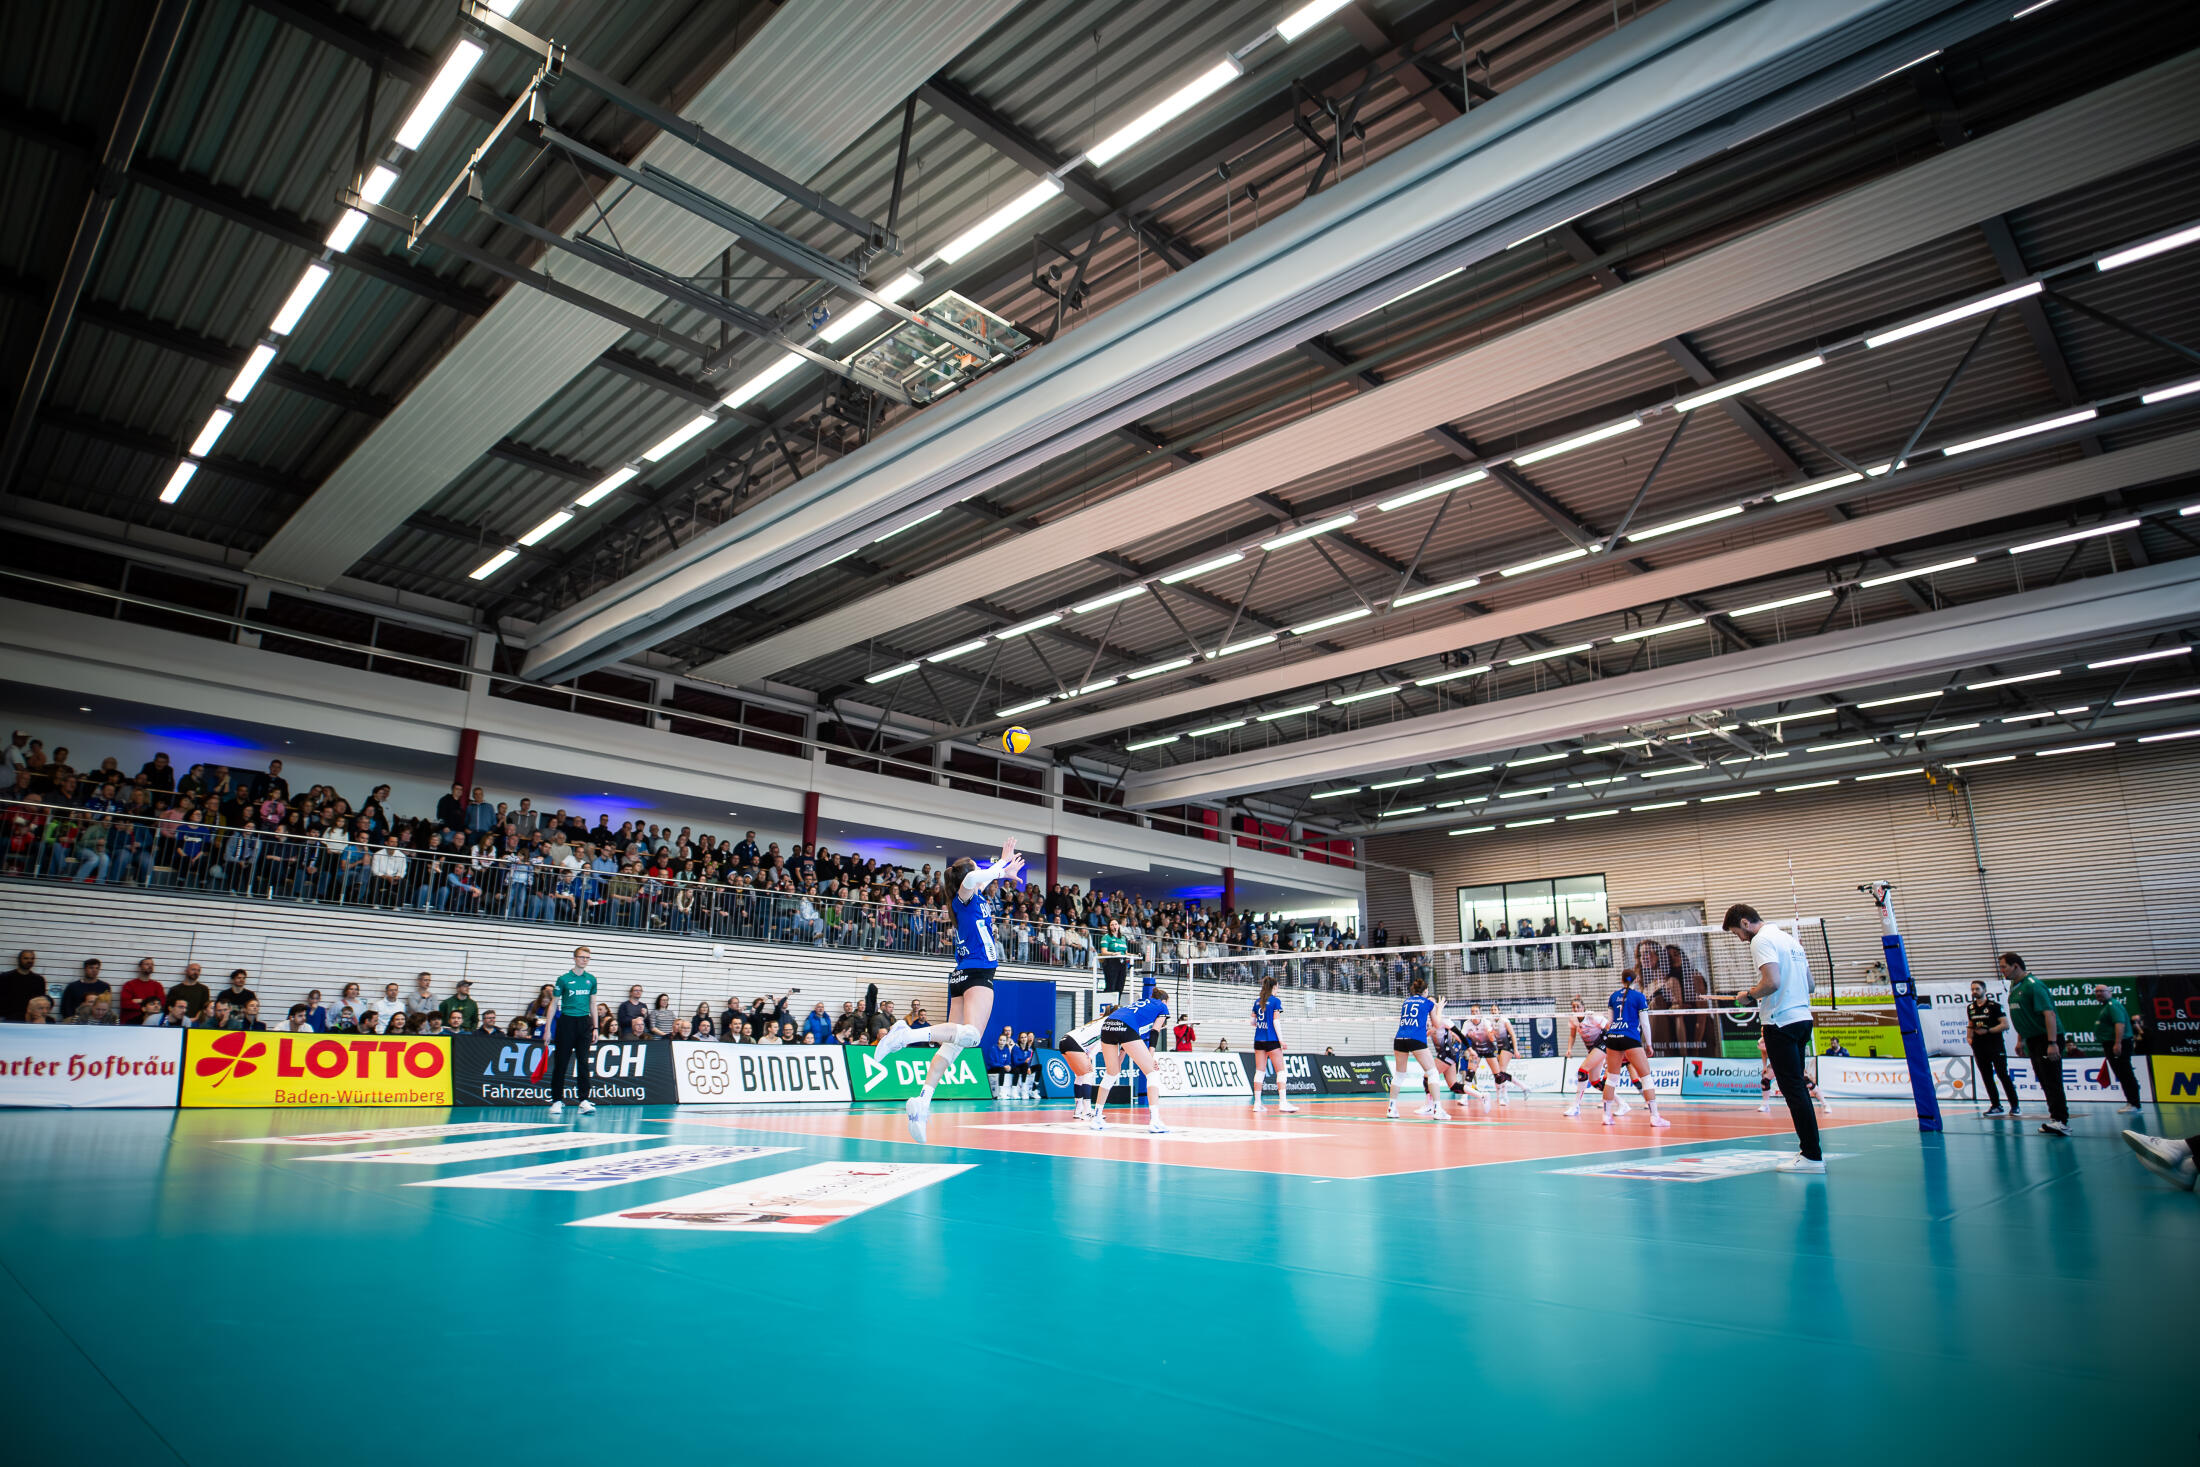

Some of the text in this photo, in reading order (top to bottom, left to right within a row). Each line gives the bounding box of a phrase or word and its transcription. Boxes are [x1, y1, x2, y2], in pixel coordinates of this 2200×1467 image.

[1936, 992, 2003, 1004] mauer
[1258, 1007, 1265, 1021] 9
[1402, 1003, 1420, 1018] 15
[1616, 1004, 1624, 1021] 1
[277, 1038, 444, 1079] LOTTO
[67, 1054, 175, 1082] Hofbräu
[739, 1055, 840, 1092] BINDER
[1184, 1060, 1244, 1088] BINDER
[274, 1089, 446, 1105] Baden-Württemberg
